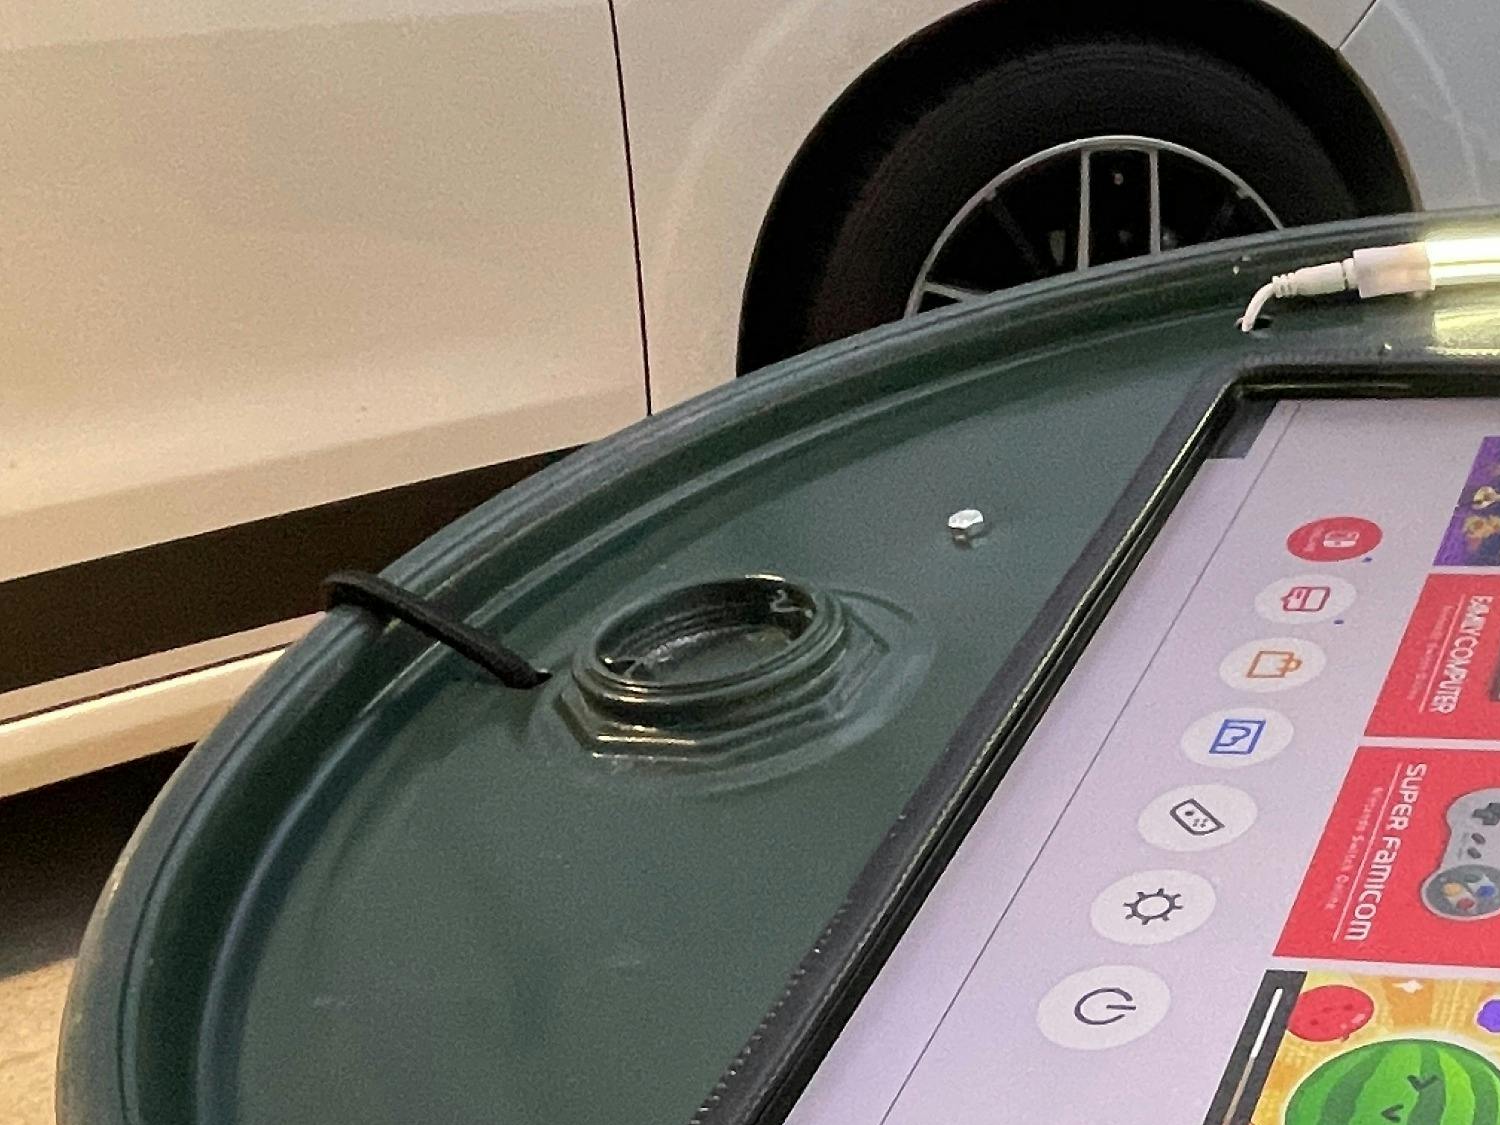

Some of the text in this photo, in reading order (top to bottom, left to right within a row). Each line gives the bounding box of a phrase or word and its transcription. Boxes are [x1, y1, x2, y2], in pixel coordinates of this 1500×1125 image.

[1459, 595, 1494, 637] FAMILY
[1429, 636, 1479, 713] COMPUTER
[1385, 763, 1428, 831] SUPER
